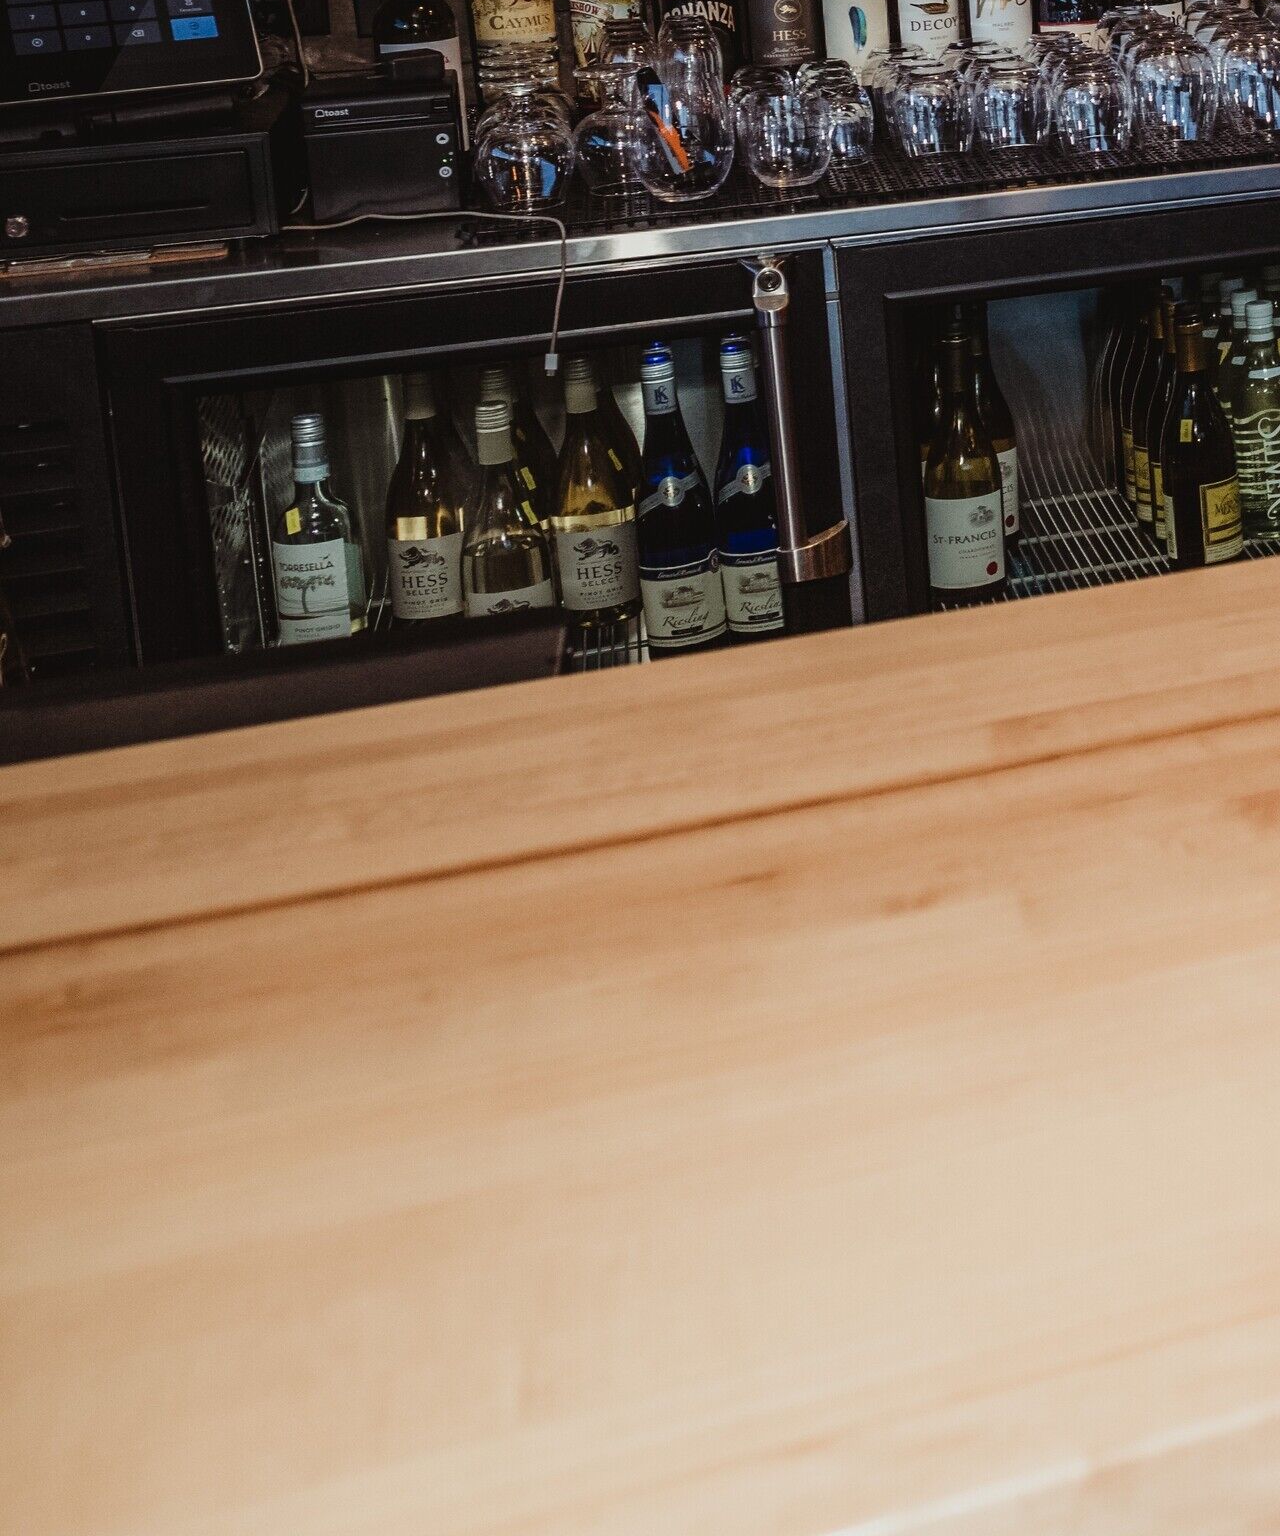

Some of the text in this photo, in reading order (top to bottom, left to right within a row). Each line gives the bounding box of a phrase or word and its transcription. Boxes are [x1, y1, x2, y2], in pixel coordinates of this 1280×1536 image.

[488, 13, 551, 30] CAYMUS
[664, 0, 736, 32] ONANZA
[910, 17, 959, 32] DECOY
[772, 29, 807, 42] HESS
[40, 80, 71, 91] toast
[324, 107, 349, 116] toast
[576, 563, 622, 581] HESS
[401, 572, 448, 589] HESS
[581, 576, 620, 588] SELECT
[406, 586, 445, 596] SELECT
[662, 606, 710, 628] Riesling
